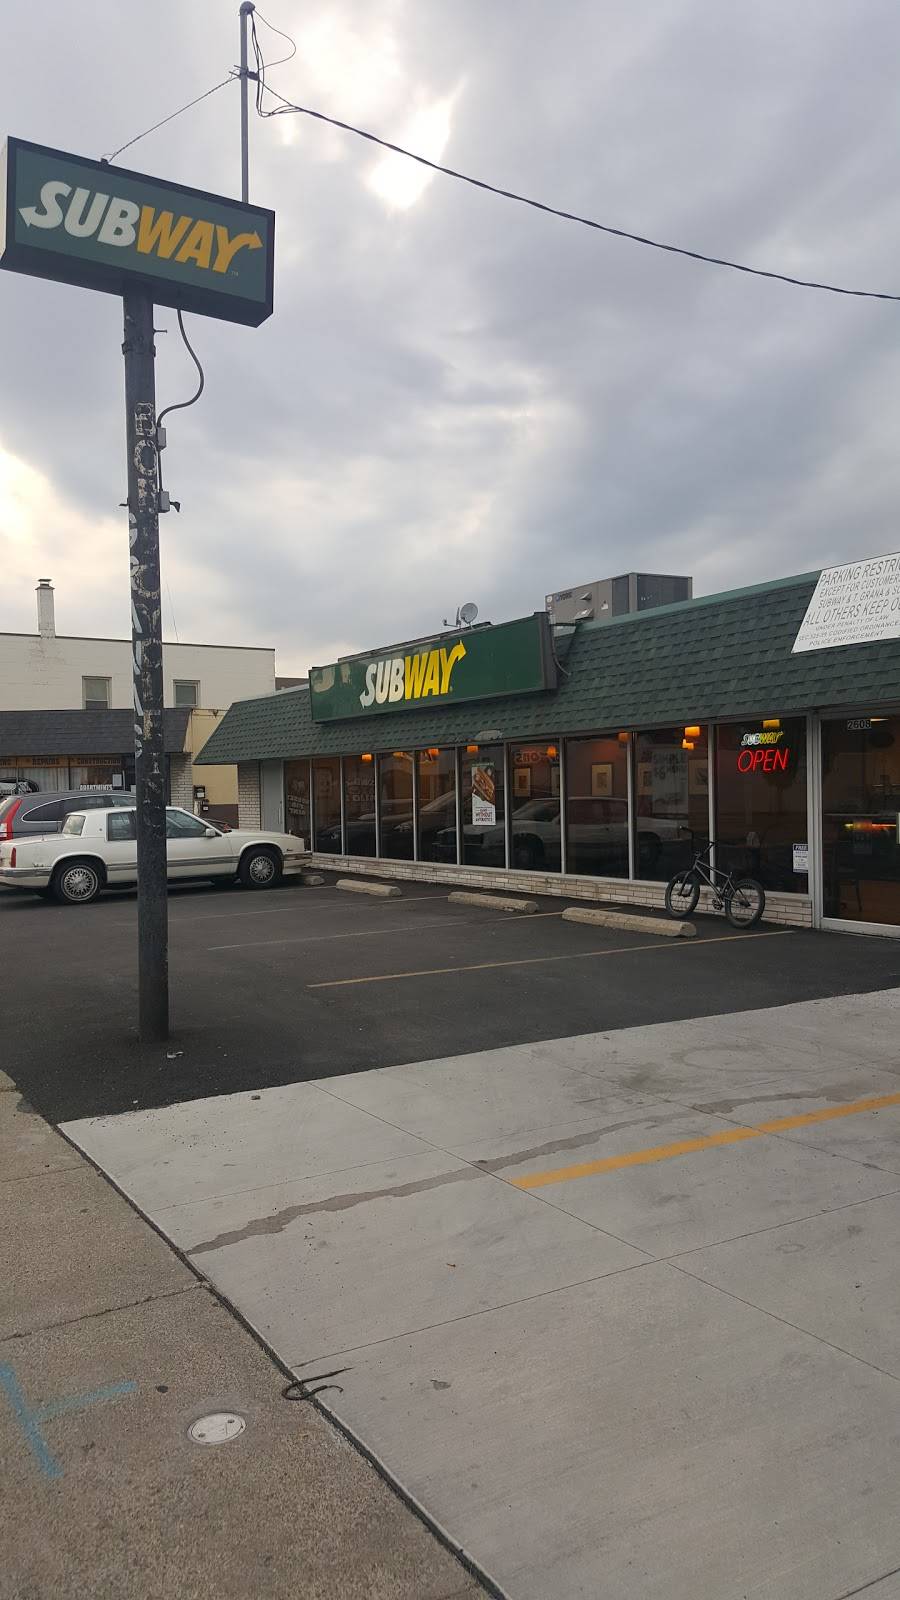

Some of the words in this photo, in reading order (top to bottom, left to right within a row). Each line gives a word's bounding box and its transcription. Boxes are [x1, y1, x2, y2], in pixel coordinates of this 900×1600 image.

[18, 181, 263, 274] SUBWAY
[818, 567, 862, 587] PARKING
[819, 584, 846, 598] EXCEPT
[845, 581, 861, 593] FOR
[818, 594, 847, 608] SUBWAY
[803, 610, 822, 627] ALL
[823, 603, 862, 623] OTHERS
[862, 598, 890, 616] KEEP
[875, 614, 890, 622] LAW
[360, 640, 467, 709] SUBWAY
[848, 719, 871, 730] 2608
[741, 731, 784, 746] SUBWAY
[737, 749, 789, 772] OPEN
